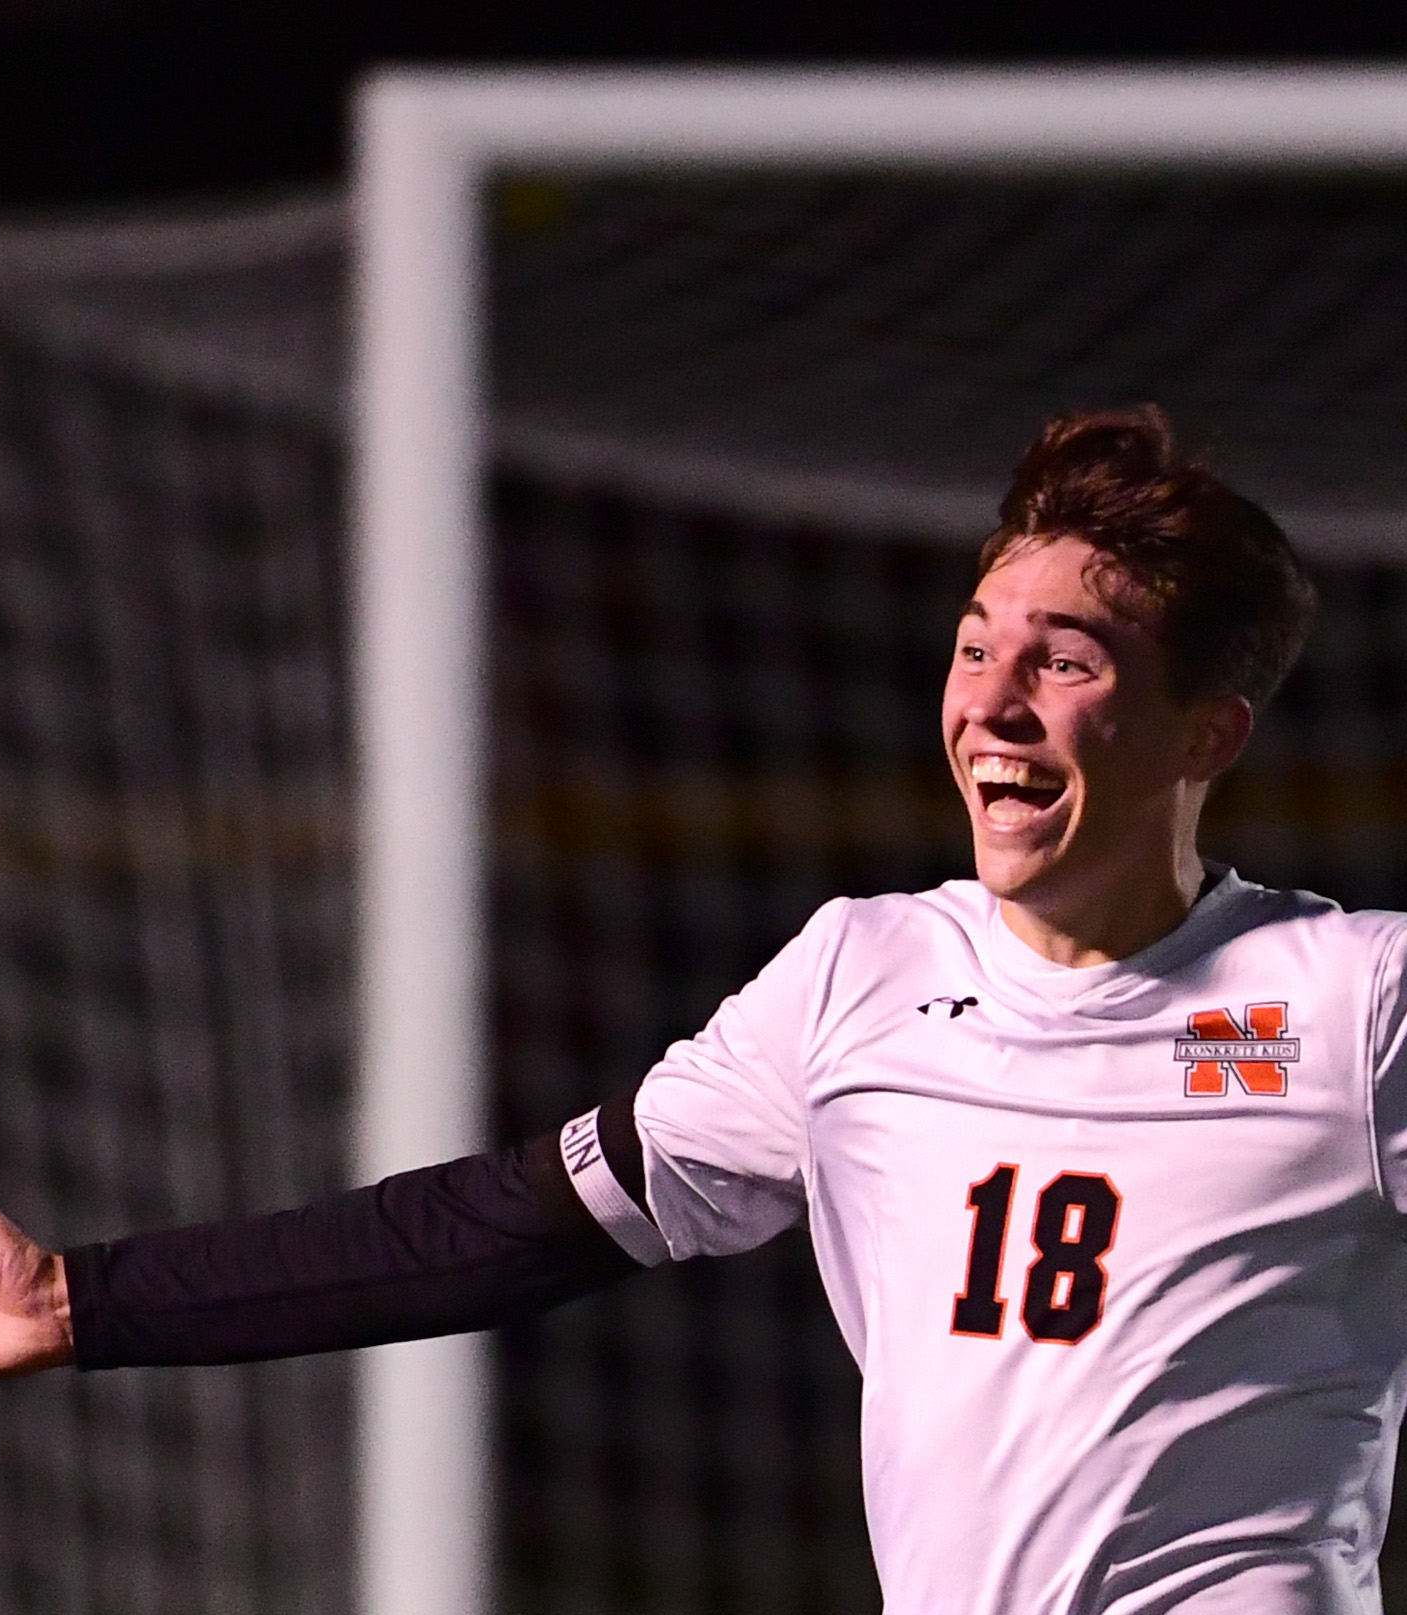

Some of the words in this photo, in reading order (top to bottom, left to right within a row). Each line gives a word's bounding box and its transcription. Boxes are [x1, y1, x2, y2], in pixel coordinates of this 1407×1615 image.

[1185, 1002, 1288, 1097] N
[1185, 1046, 1256, 1057] KONKRETE
[1262, 1045, 1293, 1056] KIDS
[949, 1162, 1123, 1346] 18
